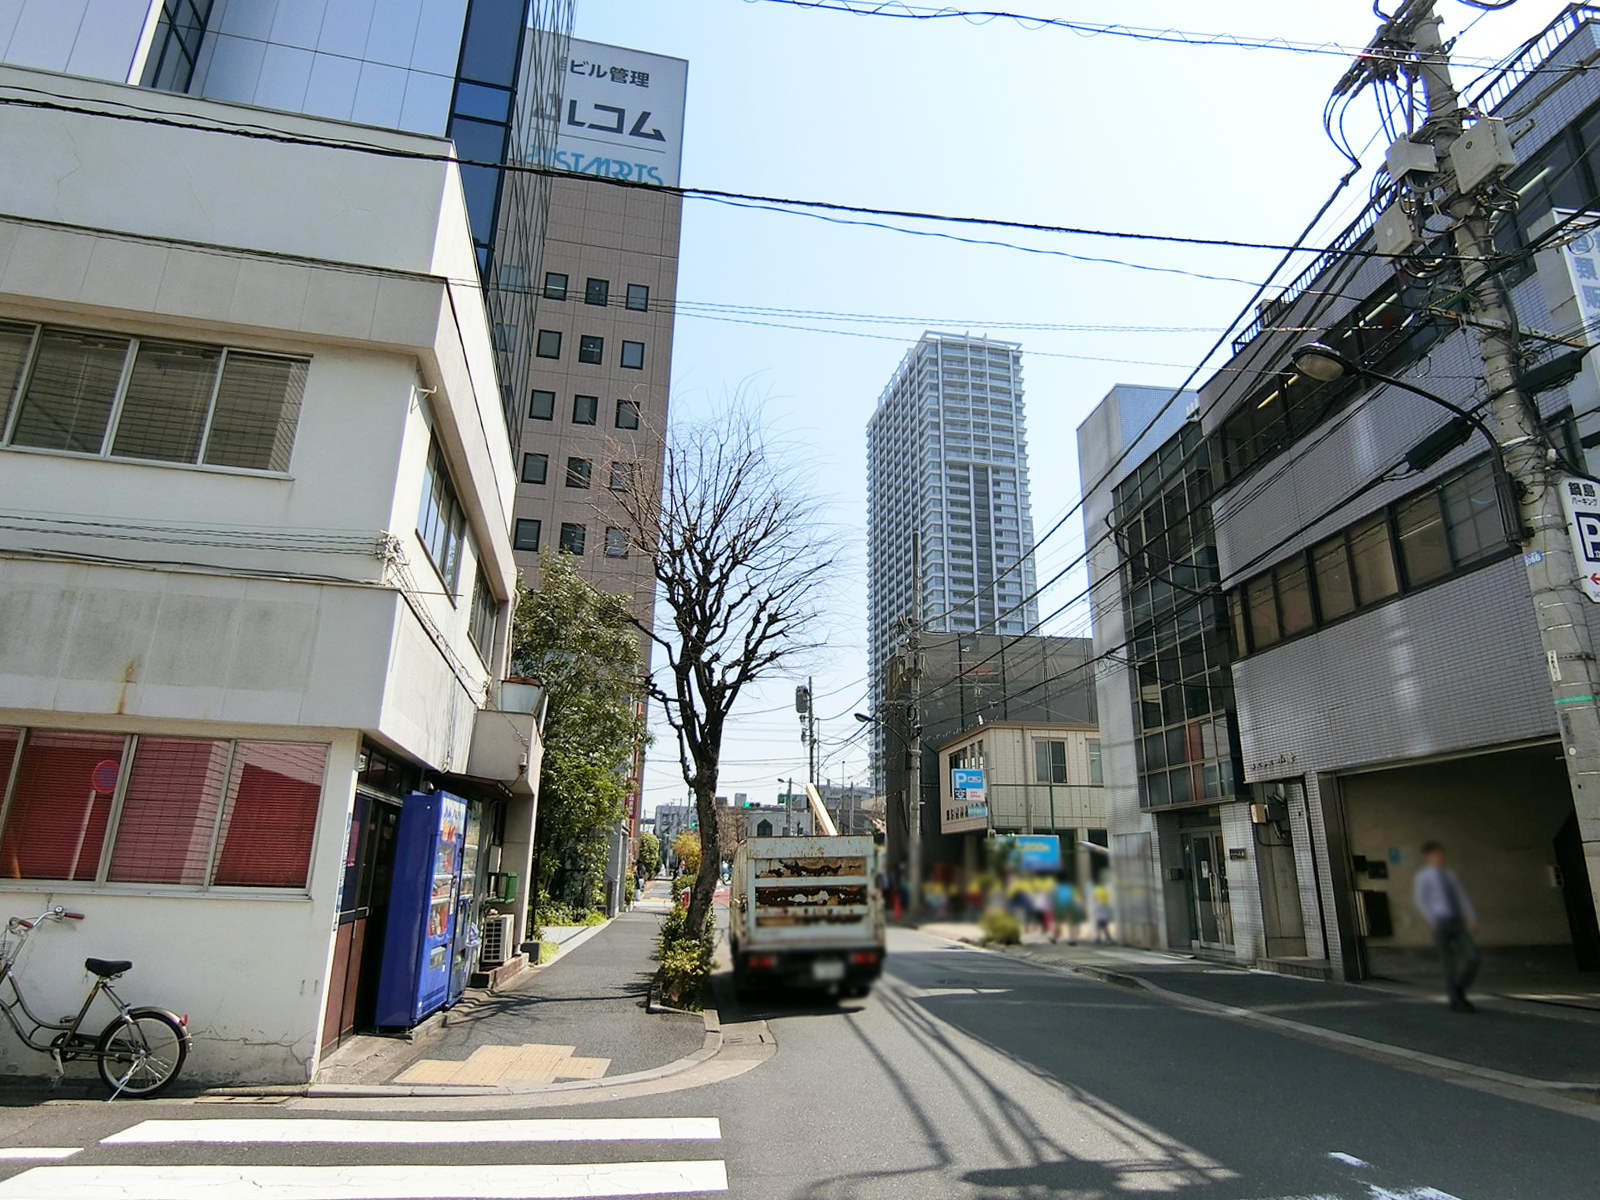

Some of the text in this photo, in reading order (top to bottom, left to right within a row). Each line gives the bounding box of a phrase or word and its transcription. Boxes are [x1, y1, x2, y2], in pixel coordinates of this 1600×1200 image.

[570, 59, 650, 88] ビル管理
[1579, 516, 1600, 559] P
[955, 773, 967, 788] P
